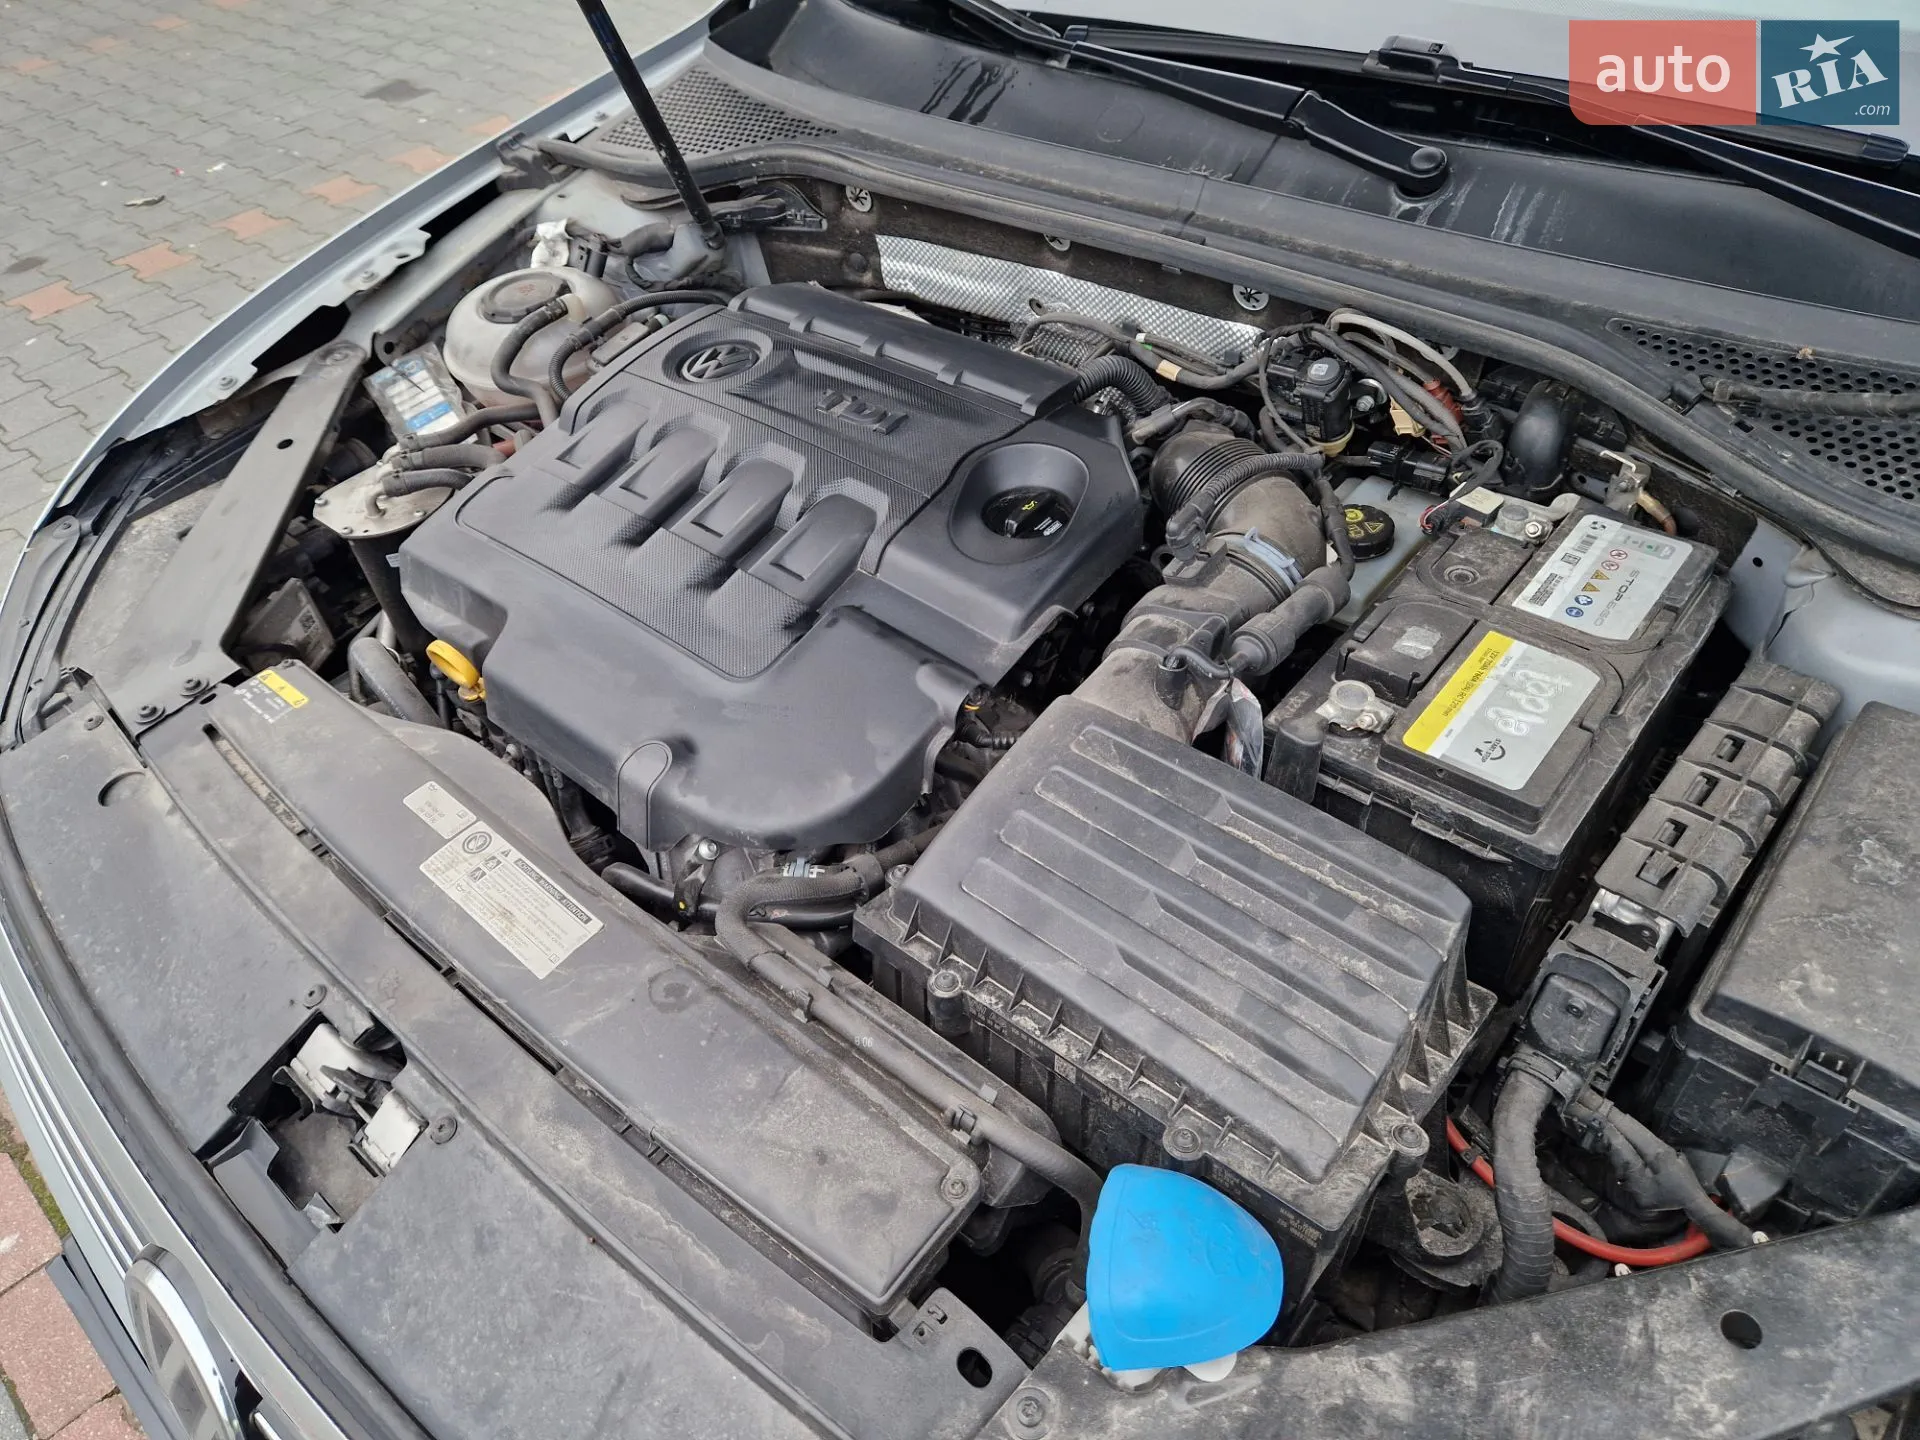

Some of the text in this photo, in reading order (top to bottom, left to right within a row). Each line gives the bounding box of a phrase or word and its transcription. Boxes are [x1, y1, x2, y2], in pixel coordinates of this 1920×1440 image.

[815, 388, 908, 435] TDI
[538, 878, 563, 900] WARNING
[560, 898, 588, 922] ATTENTION
